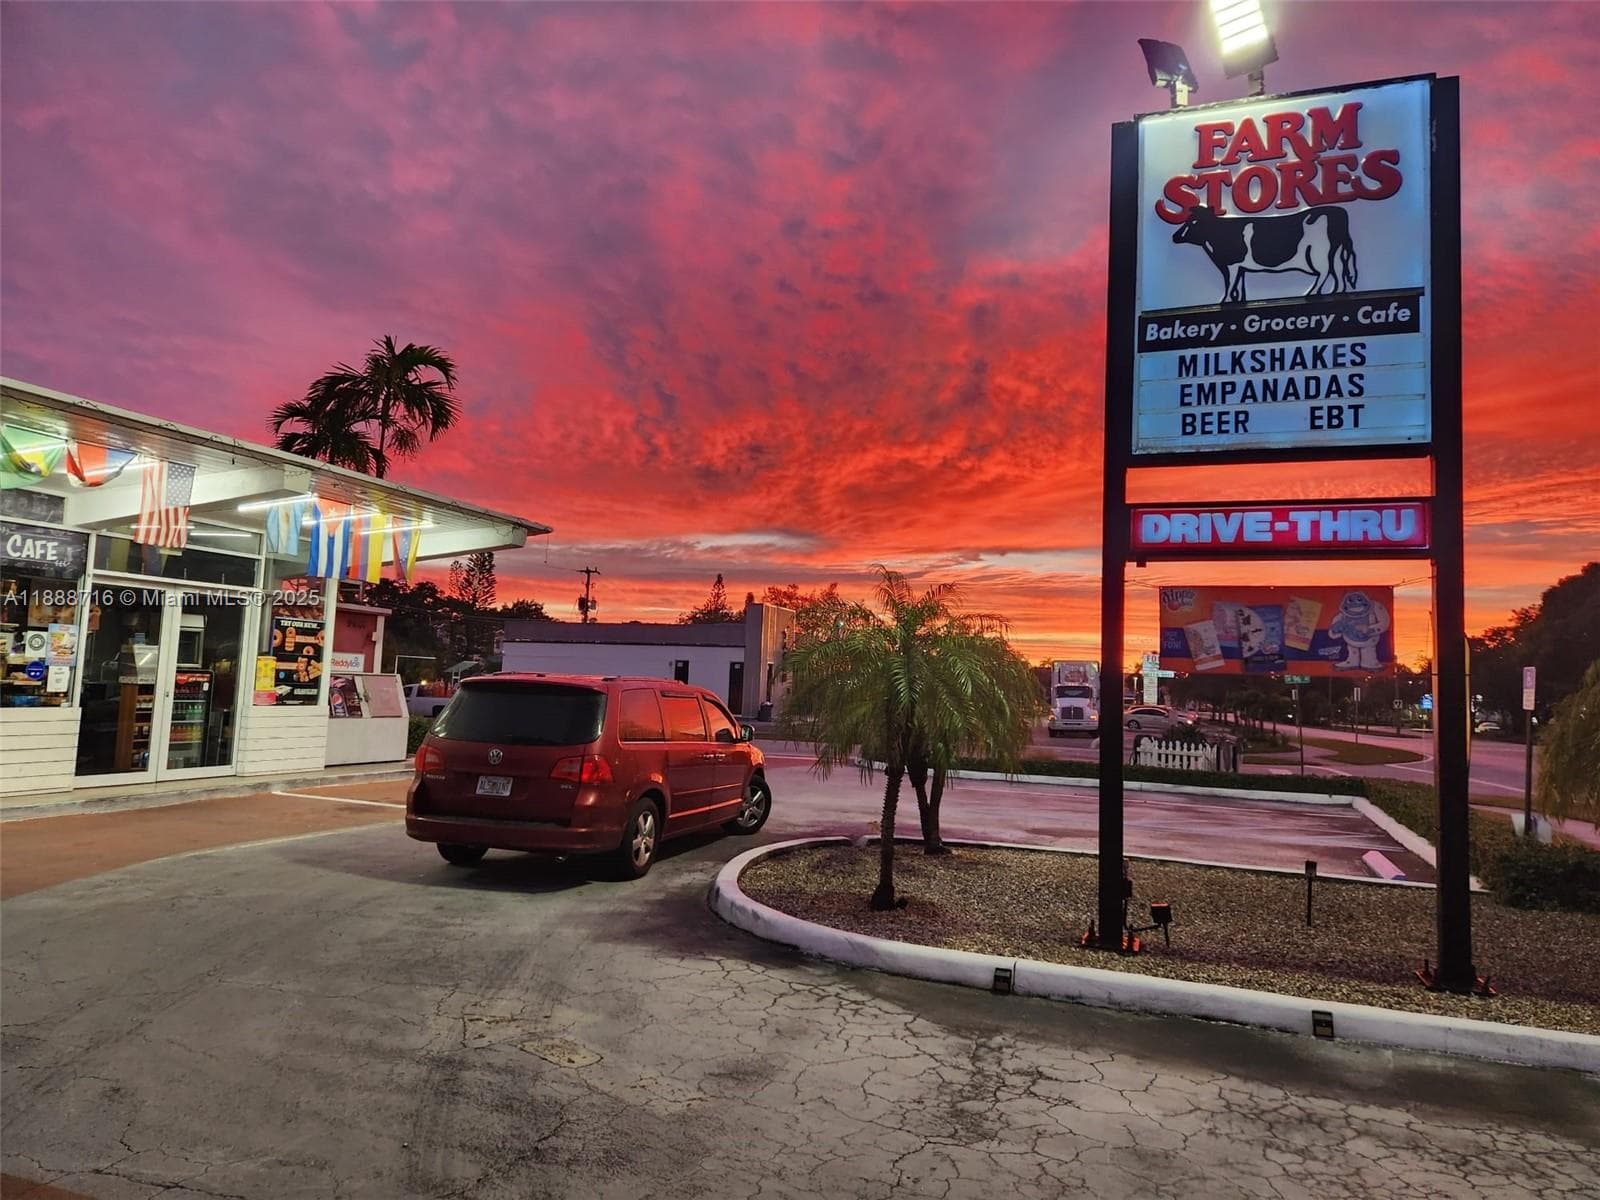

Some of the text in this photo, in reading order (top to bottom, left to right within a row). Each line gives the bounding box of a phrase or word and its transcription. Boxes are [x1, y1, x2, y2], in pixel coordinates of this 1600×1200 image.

[1192, 101, 1363, 170] FARM
[1154, 148, 1403, 226] STORES
[1145, 303, 1412, 344] Bakery Grocery Cafe
[1177, 342, 1367, 378] MILKSHAKES
[1179, 373, 1365, 408] EMPANADAS
[1181, 404, 1366, 436] BEER EBT
[1140, 508, 1416, 544] DRIVE-THRU
[6, 534, 58, 561] CAFE
